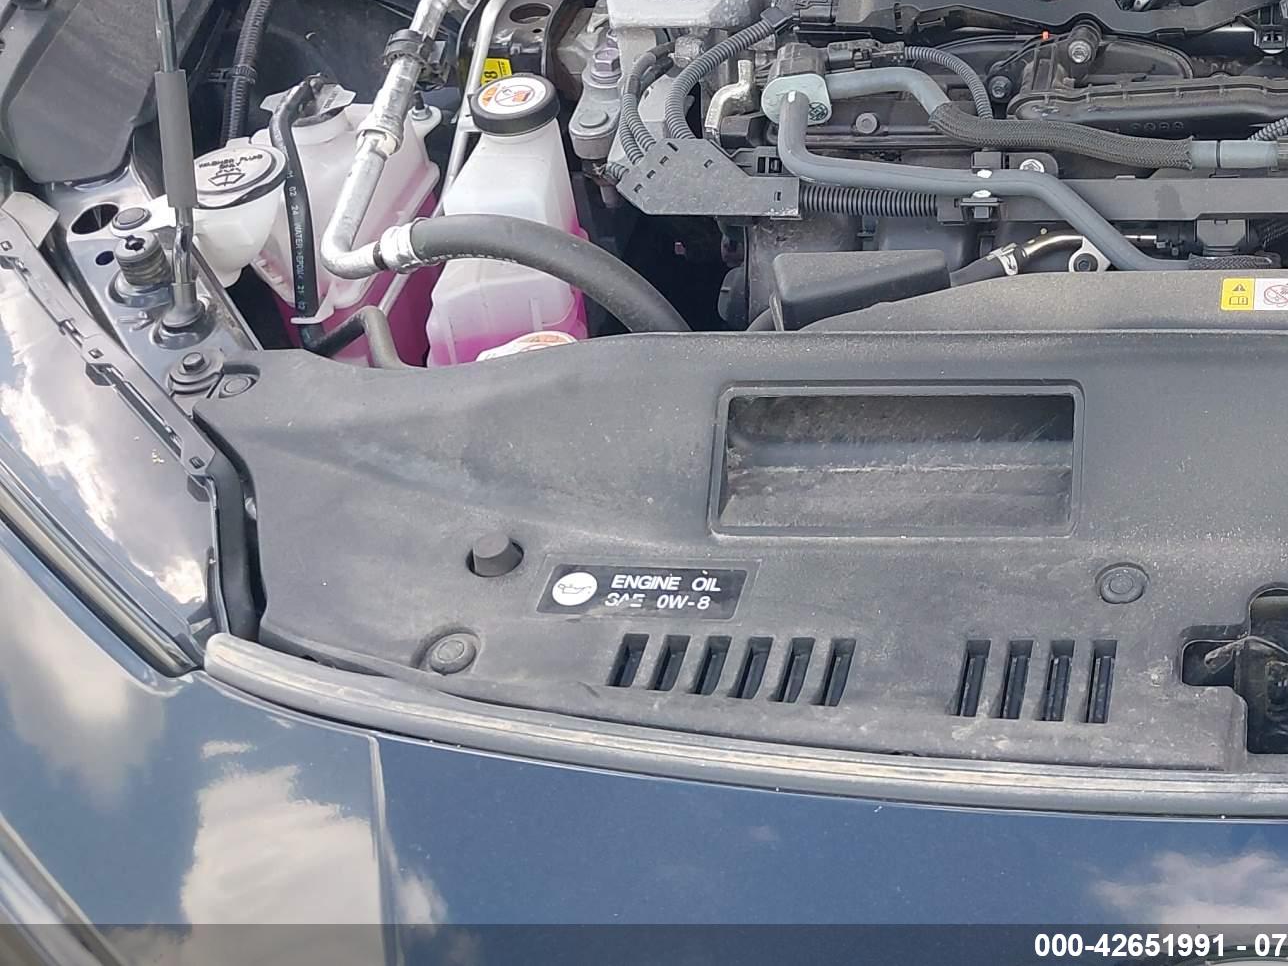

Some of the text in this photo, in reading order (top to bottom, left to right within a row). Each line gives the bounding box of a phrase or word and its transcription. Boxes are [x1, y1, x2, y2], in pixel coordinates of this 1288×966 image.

[294, 221, 304, 249] WATER
[611, 574, 721, 591] ENGINE OIL
[656, 594, 711, 610] 0W-8
